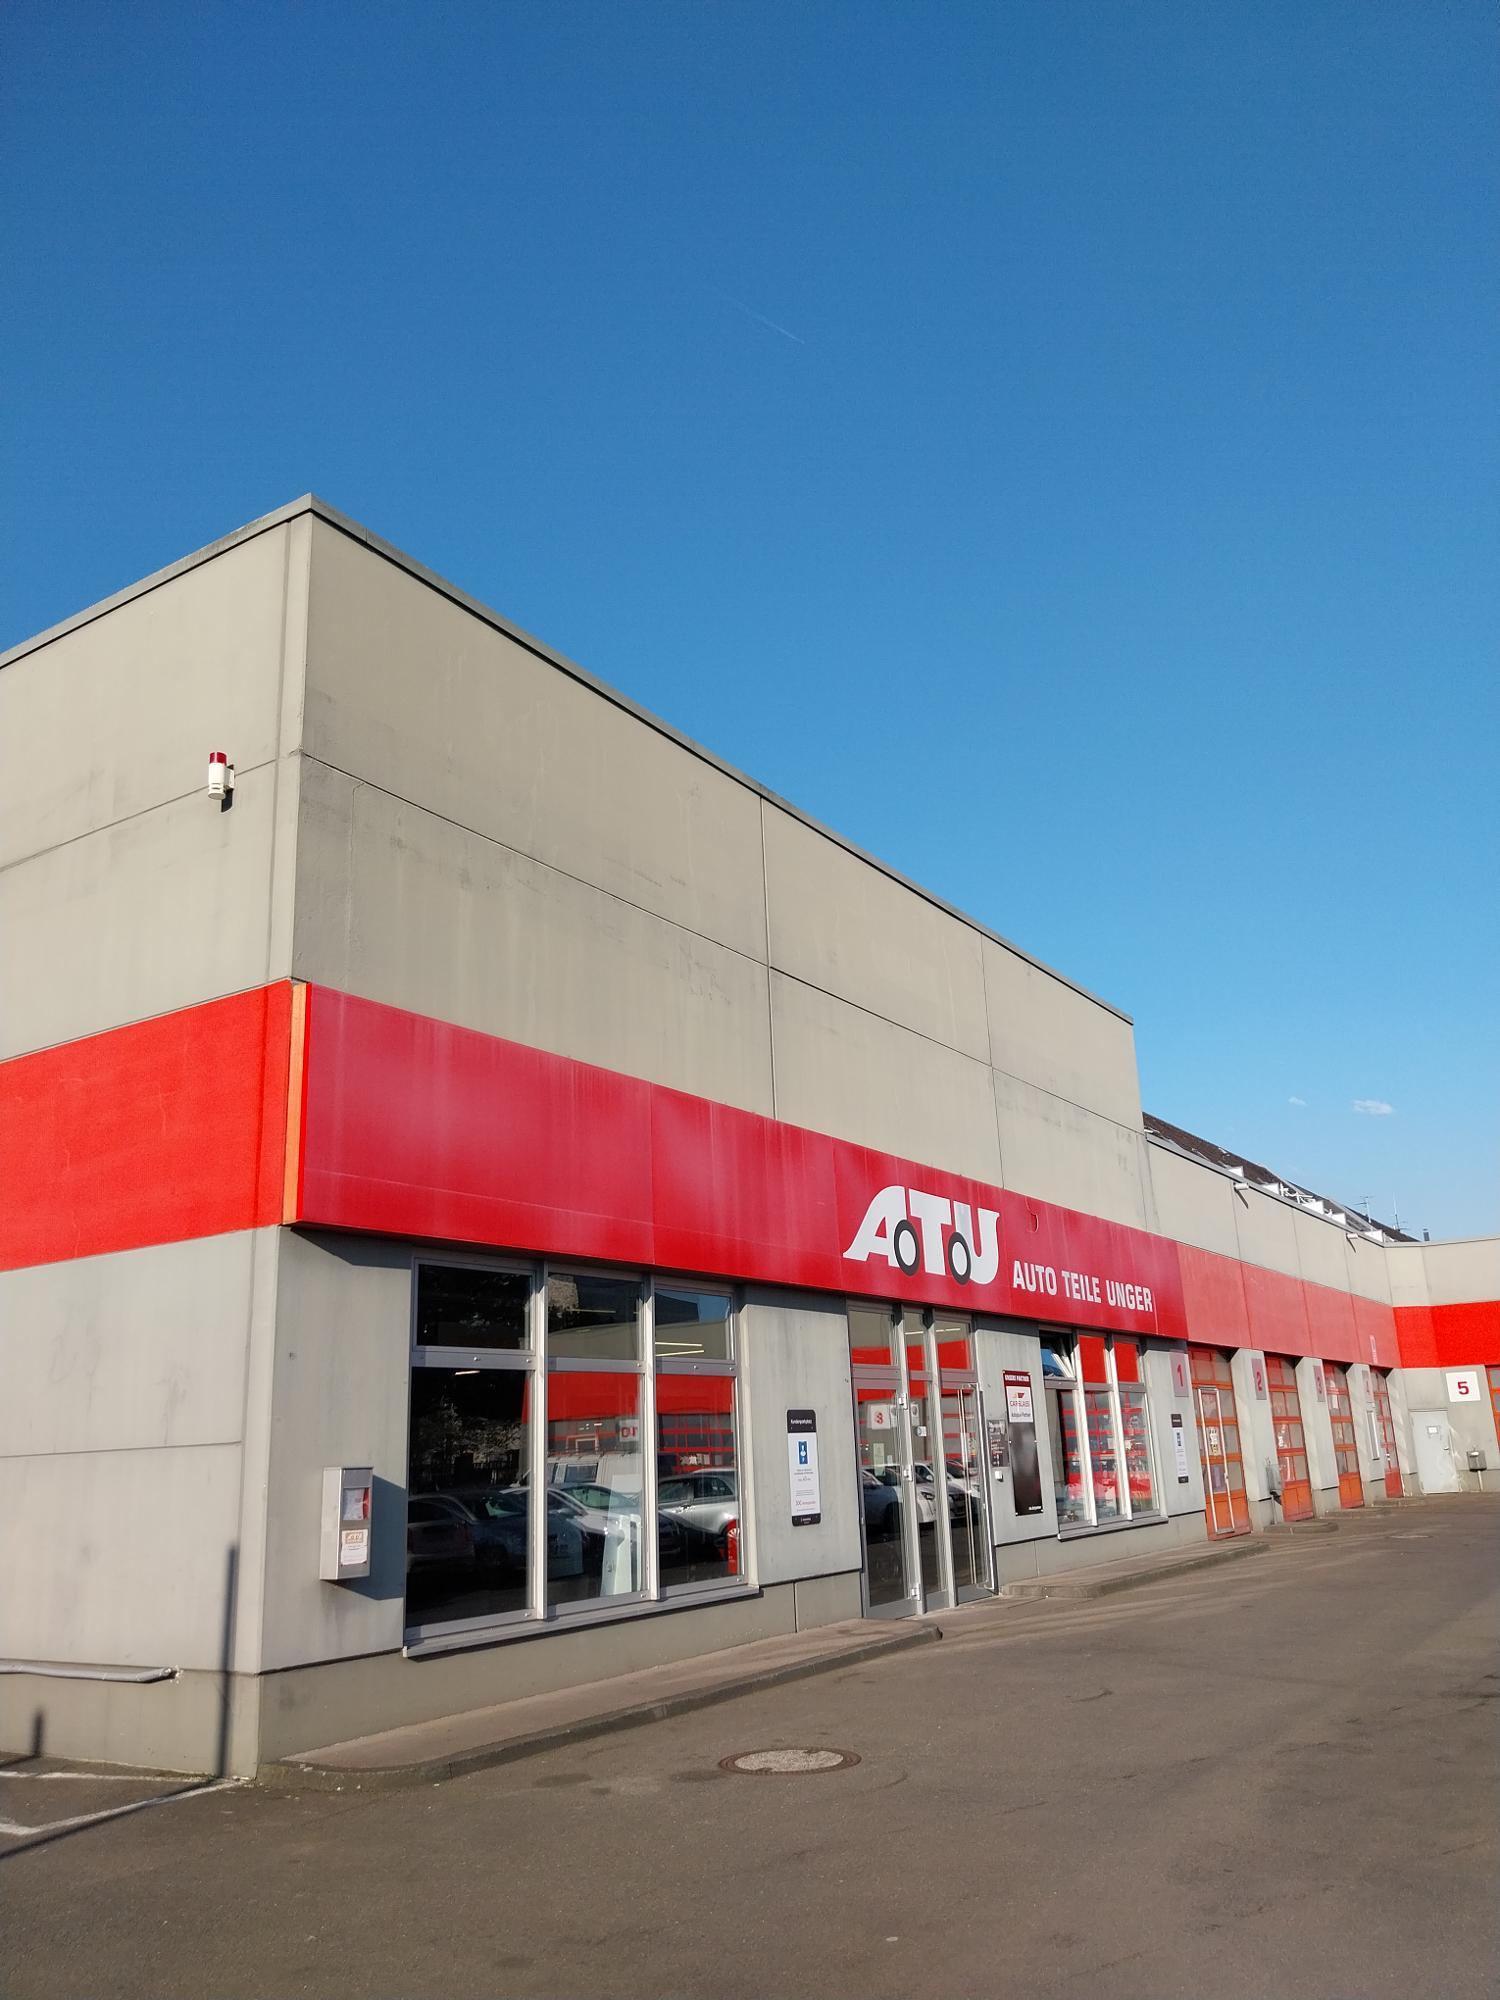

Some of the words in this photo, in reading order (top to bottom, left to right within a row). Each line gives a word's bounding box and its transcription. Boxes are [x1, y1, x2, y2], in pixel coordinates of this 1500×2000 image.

[1012, 1260, 1057, 1296] AUTO
[1061, 1271, 1102, 1304] TEILE
[1106, 1279, 1154, 1313] UNGER
[1176, 1363, 1184, 1388] 1
[1256, 1370, 1263, 1392] 2
[1457, 1381, 1470, 1395] 5
